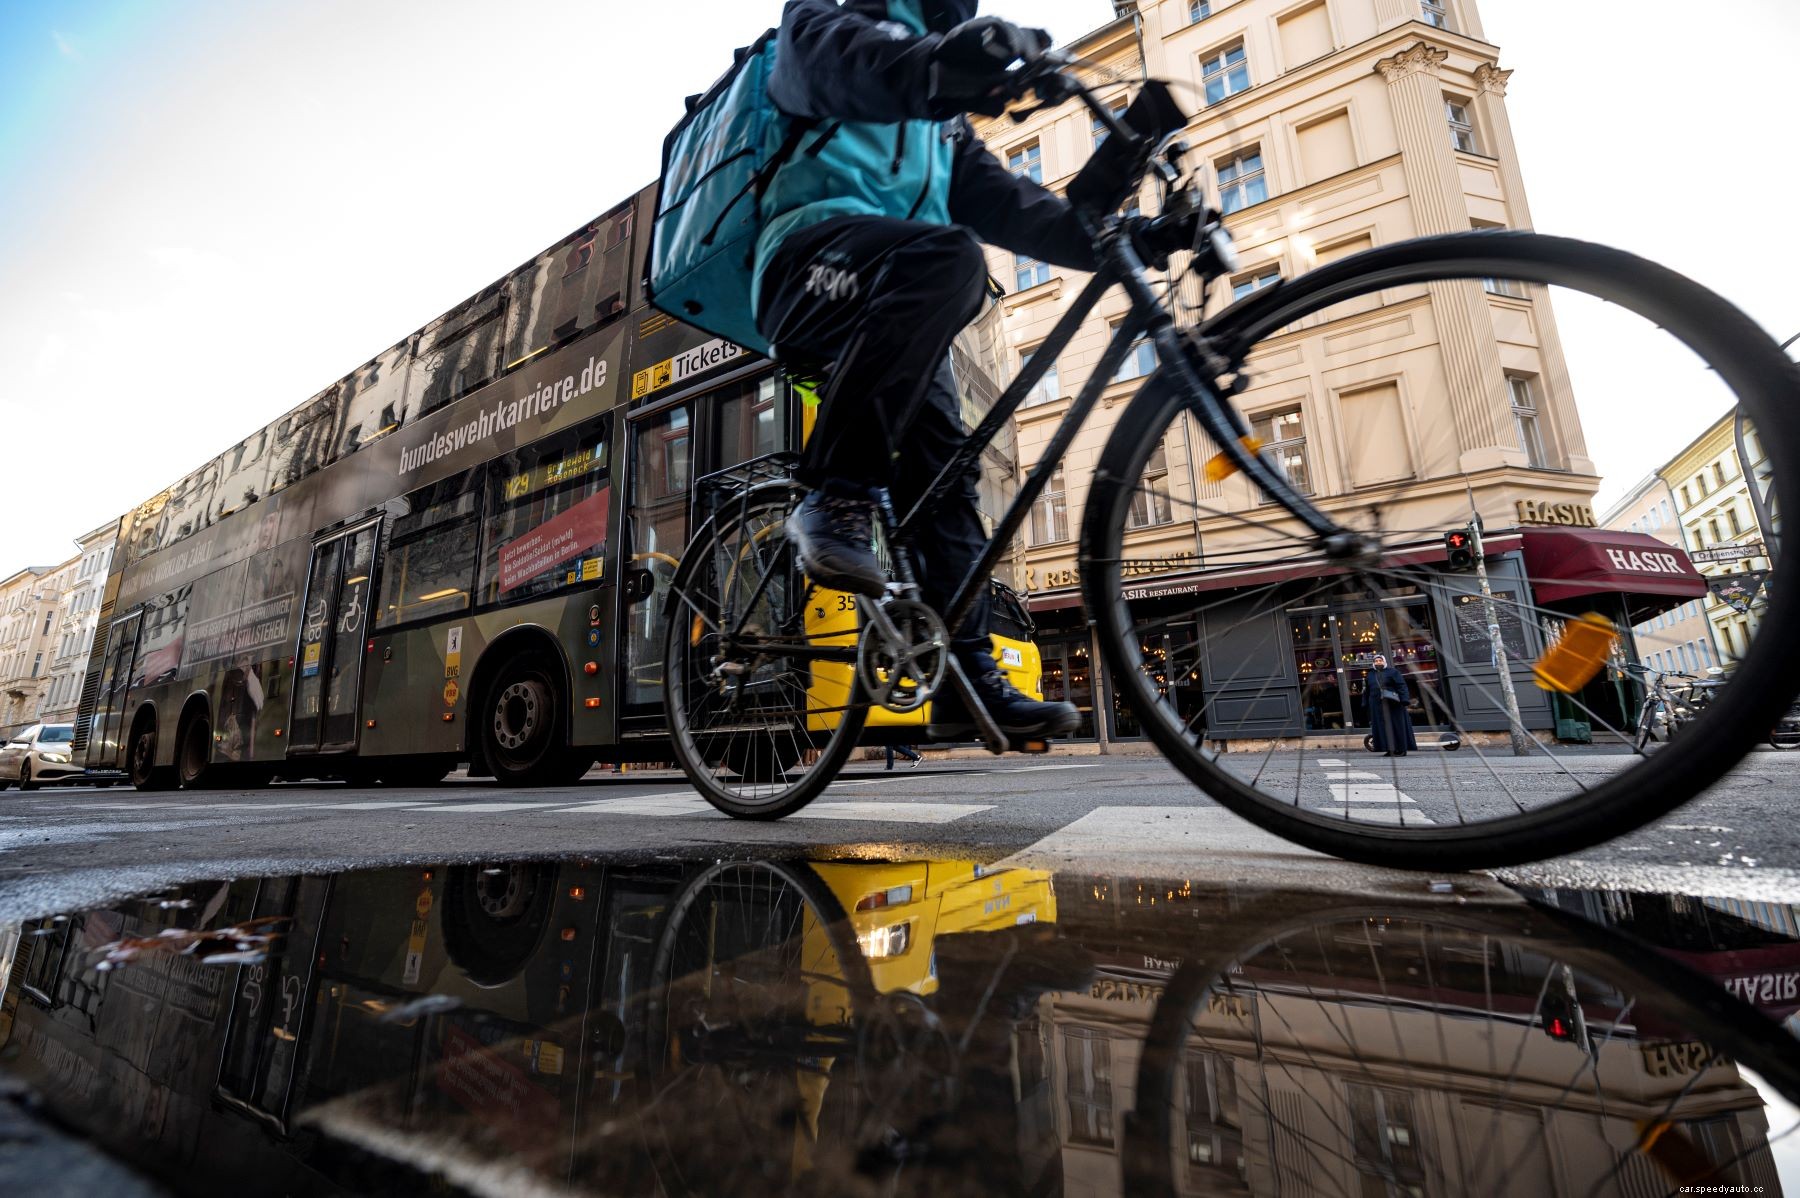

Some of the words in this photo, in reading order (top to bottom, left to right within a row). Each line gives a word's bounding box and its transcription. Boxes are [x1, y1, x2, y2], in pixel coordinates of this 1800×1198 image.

[676, 341, 738, 378] Tickets
[399, 356, 608, 476] bundeswehrkarriere.de
[547, 462, 589, 484] Roseneck
[505, 472, 530, 502] M29
[1517, 500, 1598, 527] HASIR
[1606, 549, 1686, 574] HASIR
[1121, 589, 1148, 600] ASIR
[1150, 585, 1198, 597] RESTAURANT
[236, 618, 287, 649] STILLSTEHEN.
[446, 665, 459, 677] BVG
